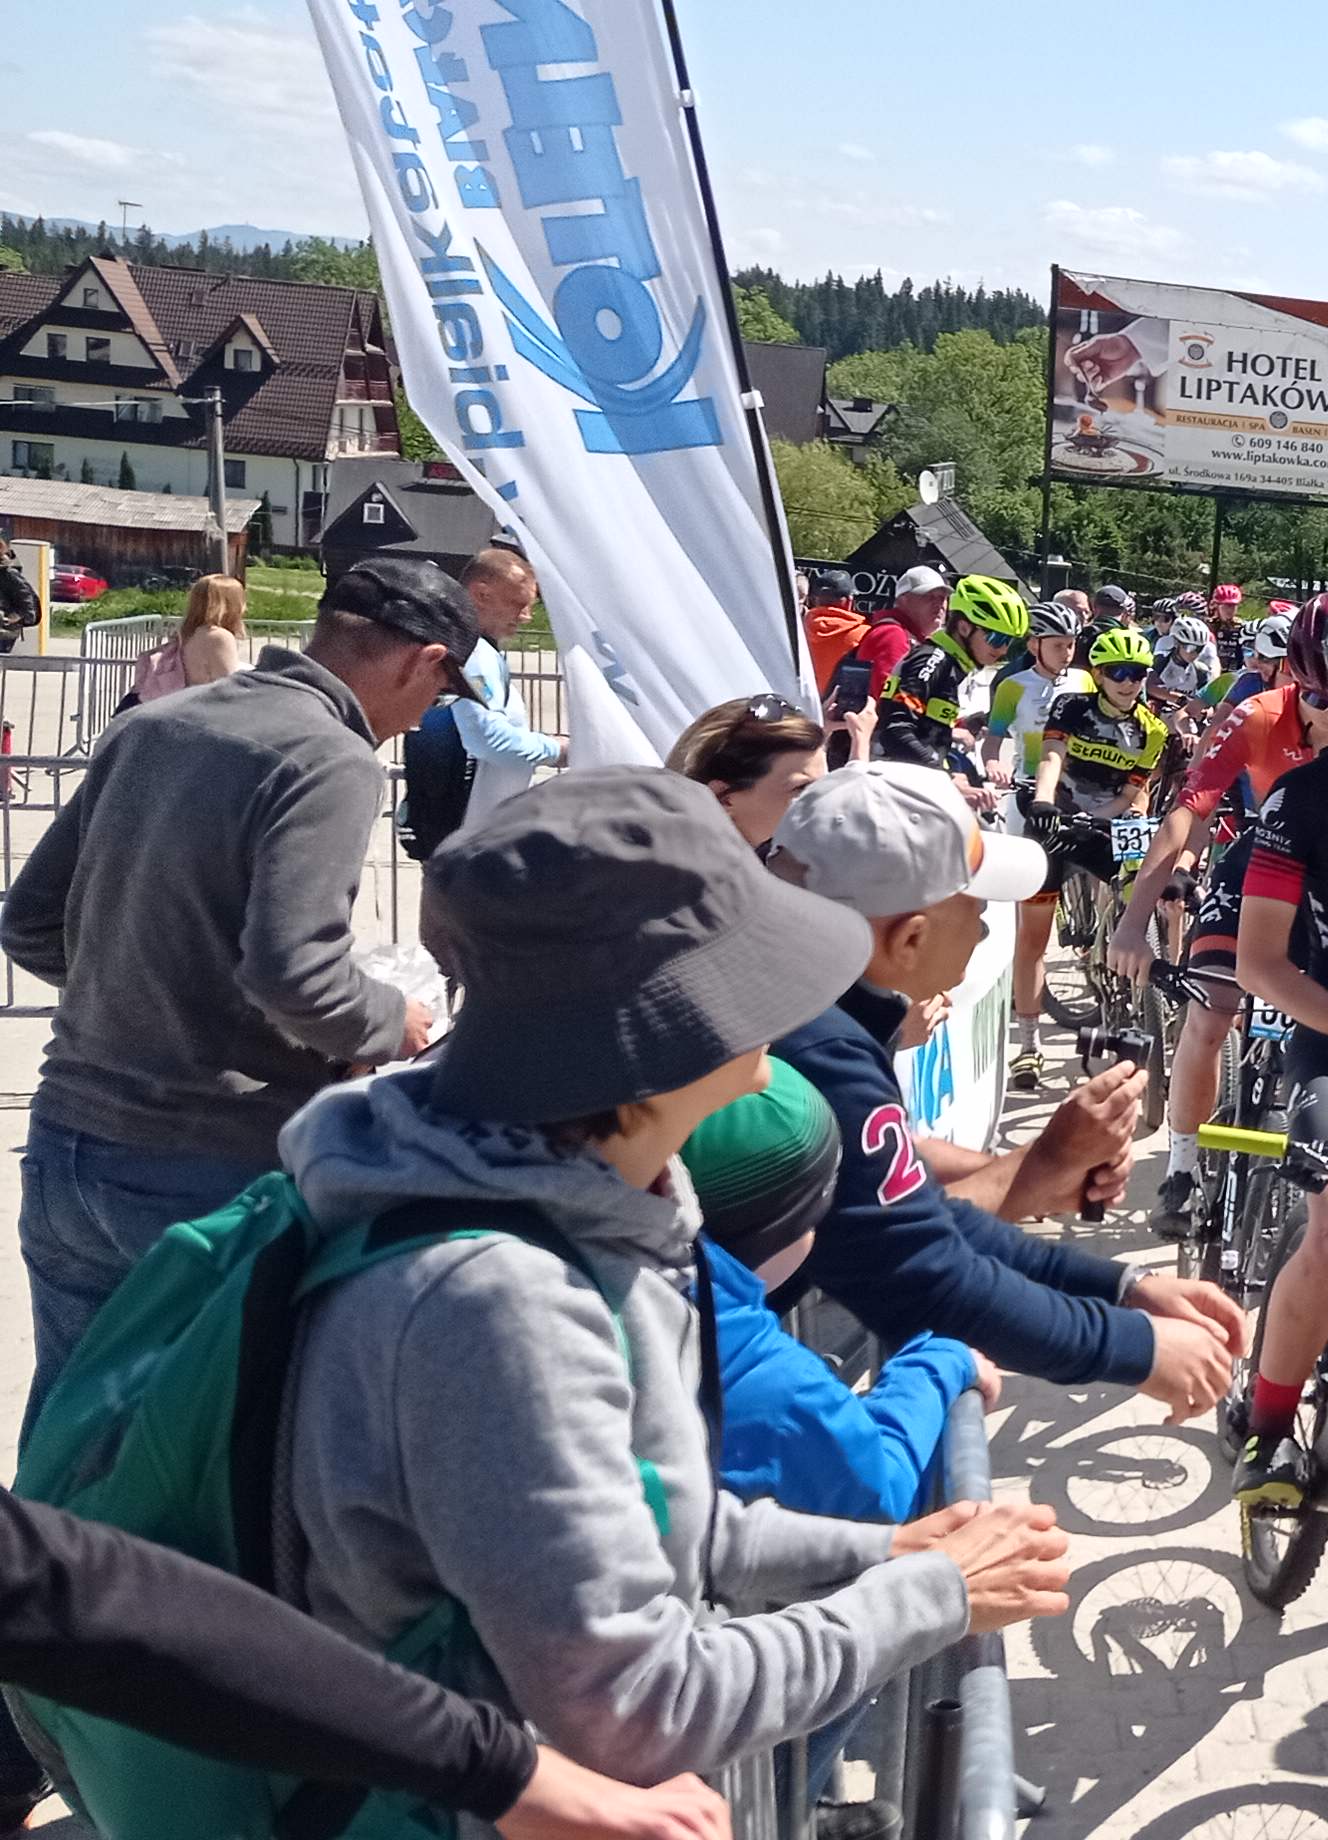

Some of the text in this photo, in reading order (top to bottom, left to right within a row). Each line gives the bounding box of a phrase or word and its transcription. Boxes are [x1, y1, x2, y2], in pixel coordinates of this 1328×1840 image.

[1226, 350, 1322, 382] HOTEL
[1176, 414, 1239, 429] RESTAURACJA
[1249, 422, 1266, 431] SPA
[1292, 426, 1321, 436] BASEN
[1249, 437, 1324, 454] 609 146 840
[1183, 466, 1231, 481] Środkowa
[862, 1102, 927, 1207] 2
